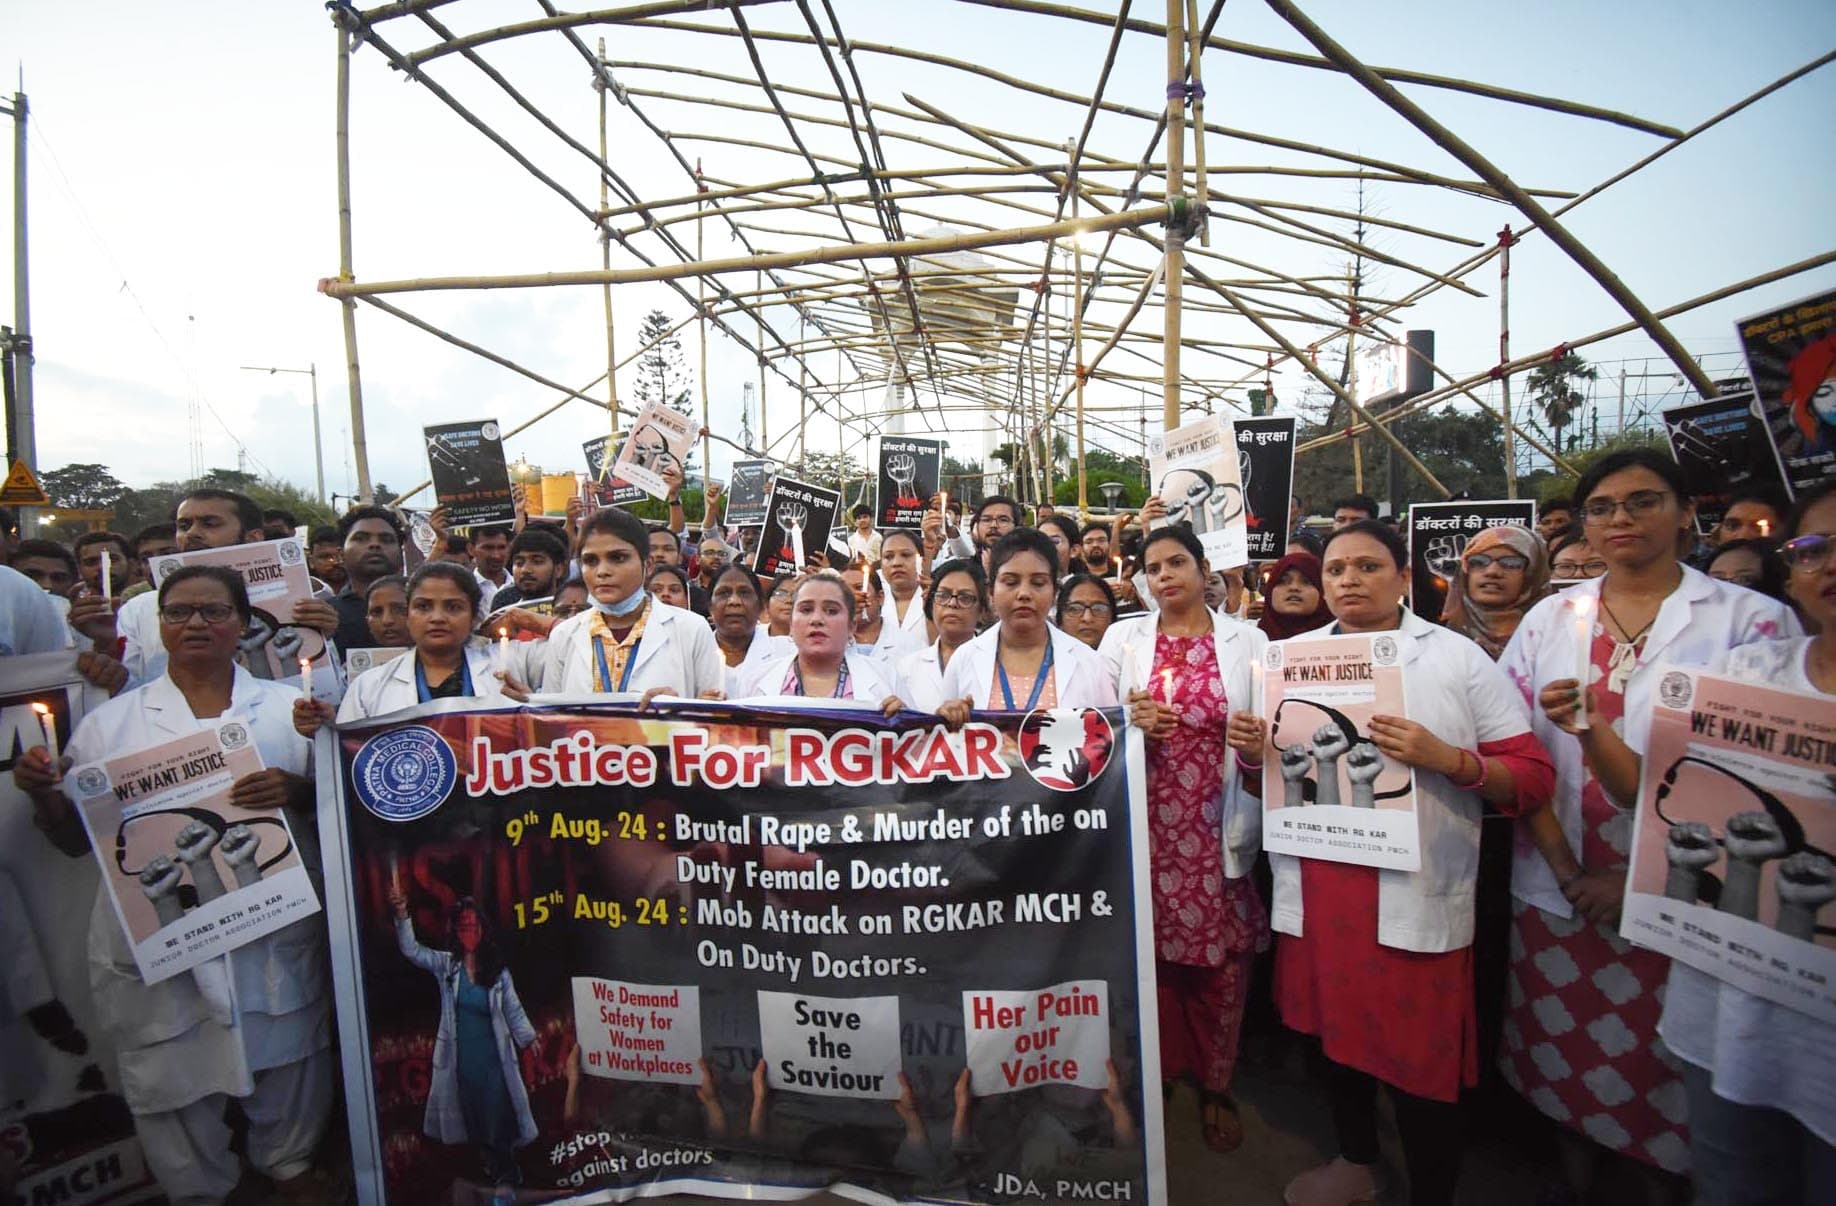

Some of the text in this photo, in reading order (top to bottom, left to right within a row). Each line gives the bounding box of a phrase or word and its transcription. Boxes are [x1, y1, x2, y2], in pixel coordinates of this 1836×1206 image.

[907, 443, 917, 453] की
[918, 446, 937, 455] सुरक्षा
[1177, 442, 1198, 457] WANT
[1238, 429, 1289, 446] की सुरक्षा
[775, 485, 834, 508] डॉक्टरों की सुरक्षा
[1415, 515, 1461, 530] डॉक्टरों
[1463, 515, 1483, 529] की
[248, 563, 284, 583] JUSTICE
[1283, 663, 1374, 682] WE WANT JUSTICE
[1690, 709, 1718, 738] WE
[1722, 717, 1779, 753] WANT
[371, 742, 439, 797] PATNA MEDICAL COLLEGE
[467, 723, 1011, 796] Justice For RGKAR
[112, 751, 228, 801] WE WANT JUSTICE
[505, 804, 1108, 853] 9th Aug. 24 : Brutal Rape & Murder of the on
[1269, 832, 1293, 840] JUNIOR
[1296, 835, 1323, 844] DOCTOR
[1327, 839, 1382, 852] ASSOCIATION
[1296, 822, 1322, 832] STAND
[1327, 826, 1349, 835] WITH
[1369, 831, 1387, 839] KAR
[677, 856, 950, 893] Duty Female Doctor.
[184, 923, 215, 941] STAND
[219, 911, 244, 926] WITH
[264, 894, 283, 906] KAR
[514, 889, 1113, 935] 15th Aug. 24 : Mob Attack on RGKAR MCH &
[150, 950, 183, 969] JUNIOR
[187, 934, 220, 953] DOCTOR
[224, 907, 282, 937] ASSOCIATION
[1682, 921, 1721, 944] STAND
[697, 940, 927, 982] On Duty Doctors.
[592, 981, 679, 1009] We Demand
[972, 986, 1100, 1030] Her Pain
[599, 1005, 673, 1033] Safety for
[794, 1000, 861, 1031] Save
[609, 1029, 665, 1052] Women
[807, 1032, 852, 1061] the
[1014, 1024, 1060, 1054] our
[587, 1052, 602, 1066] at
[606, 1051, 693, 1077] Workplaces
[780, 1060, 884, 1092] Saviour
[1001, 1055, 1078, 1088] Voice
[549, 1130, 611, 1165] #stop
[556, 1147, 714, 1188] against doctors
[993, 1173, 1046, 1201] JDA,
[1056, 1179, 1132, 1201] PMCH
